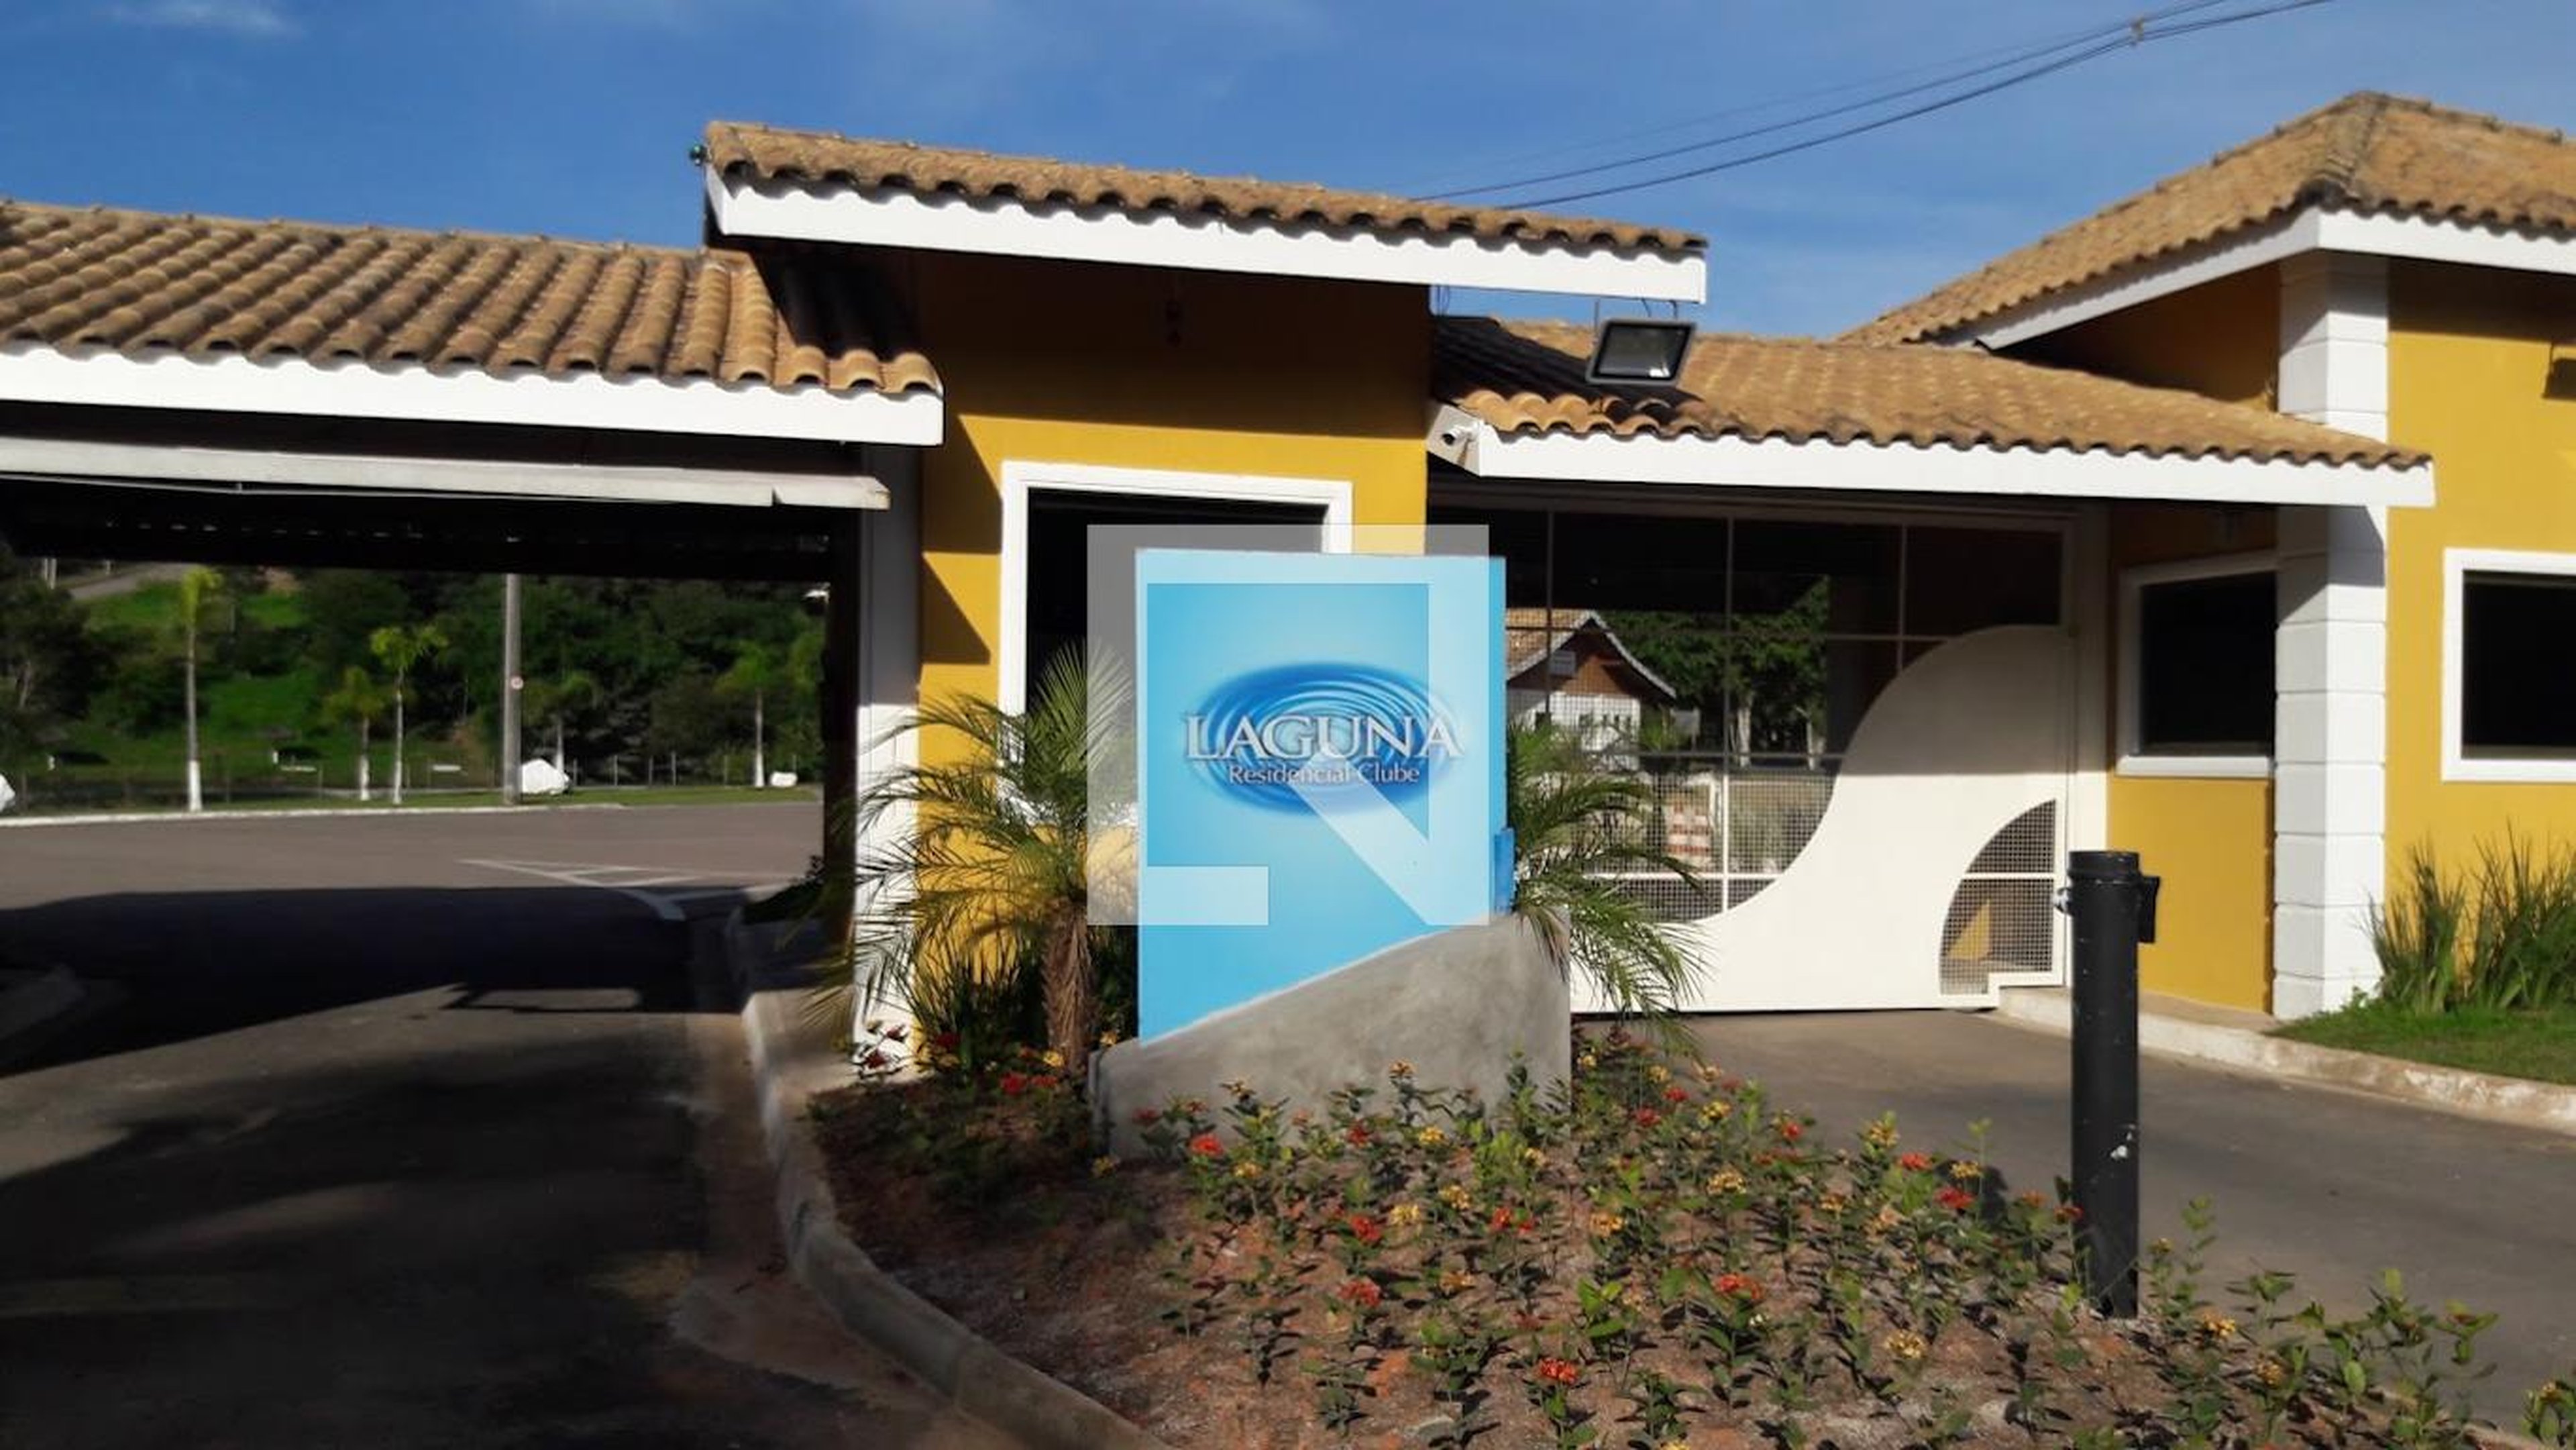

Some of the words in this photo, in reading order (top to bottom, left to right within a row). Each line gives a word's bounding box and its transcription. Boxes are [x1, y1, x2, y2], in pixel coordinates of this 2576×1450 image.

[1186, 714, 1464, 759] LAGUNA
[1229, 762, 1350, 784] Residencial
[1358, 761, 1420, 784] Clube
